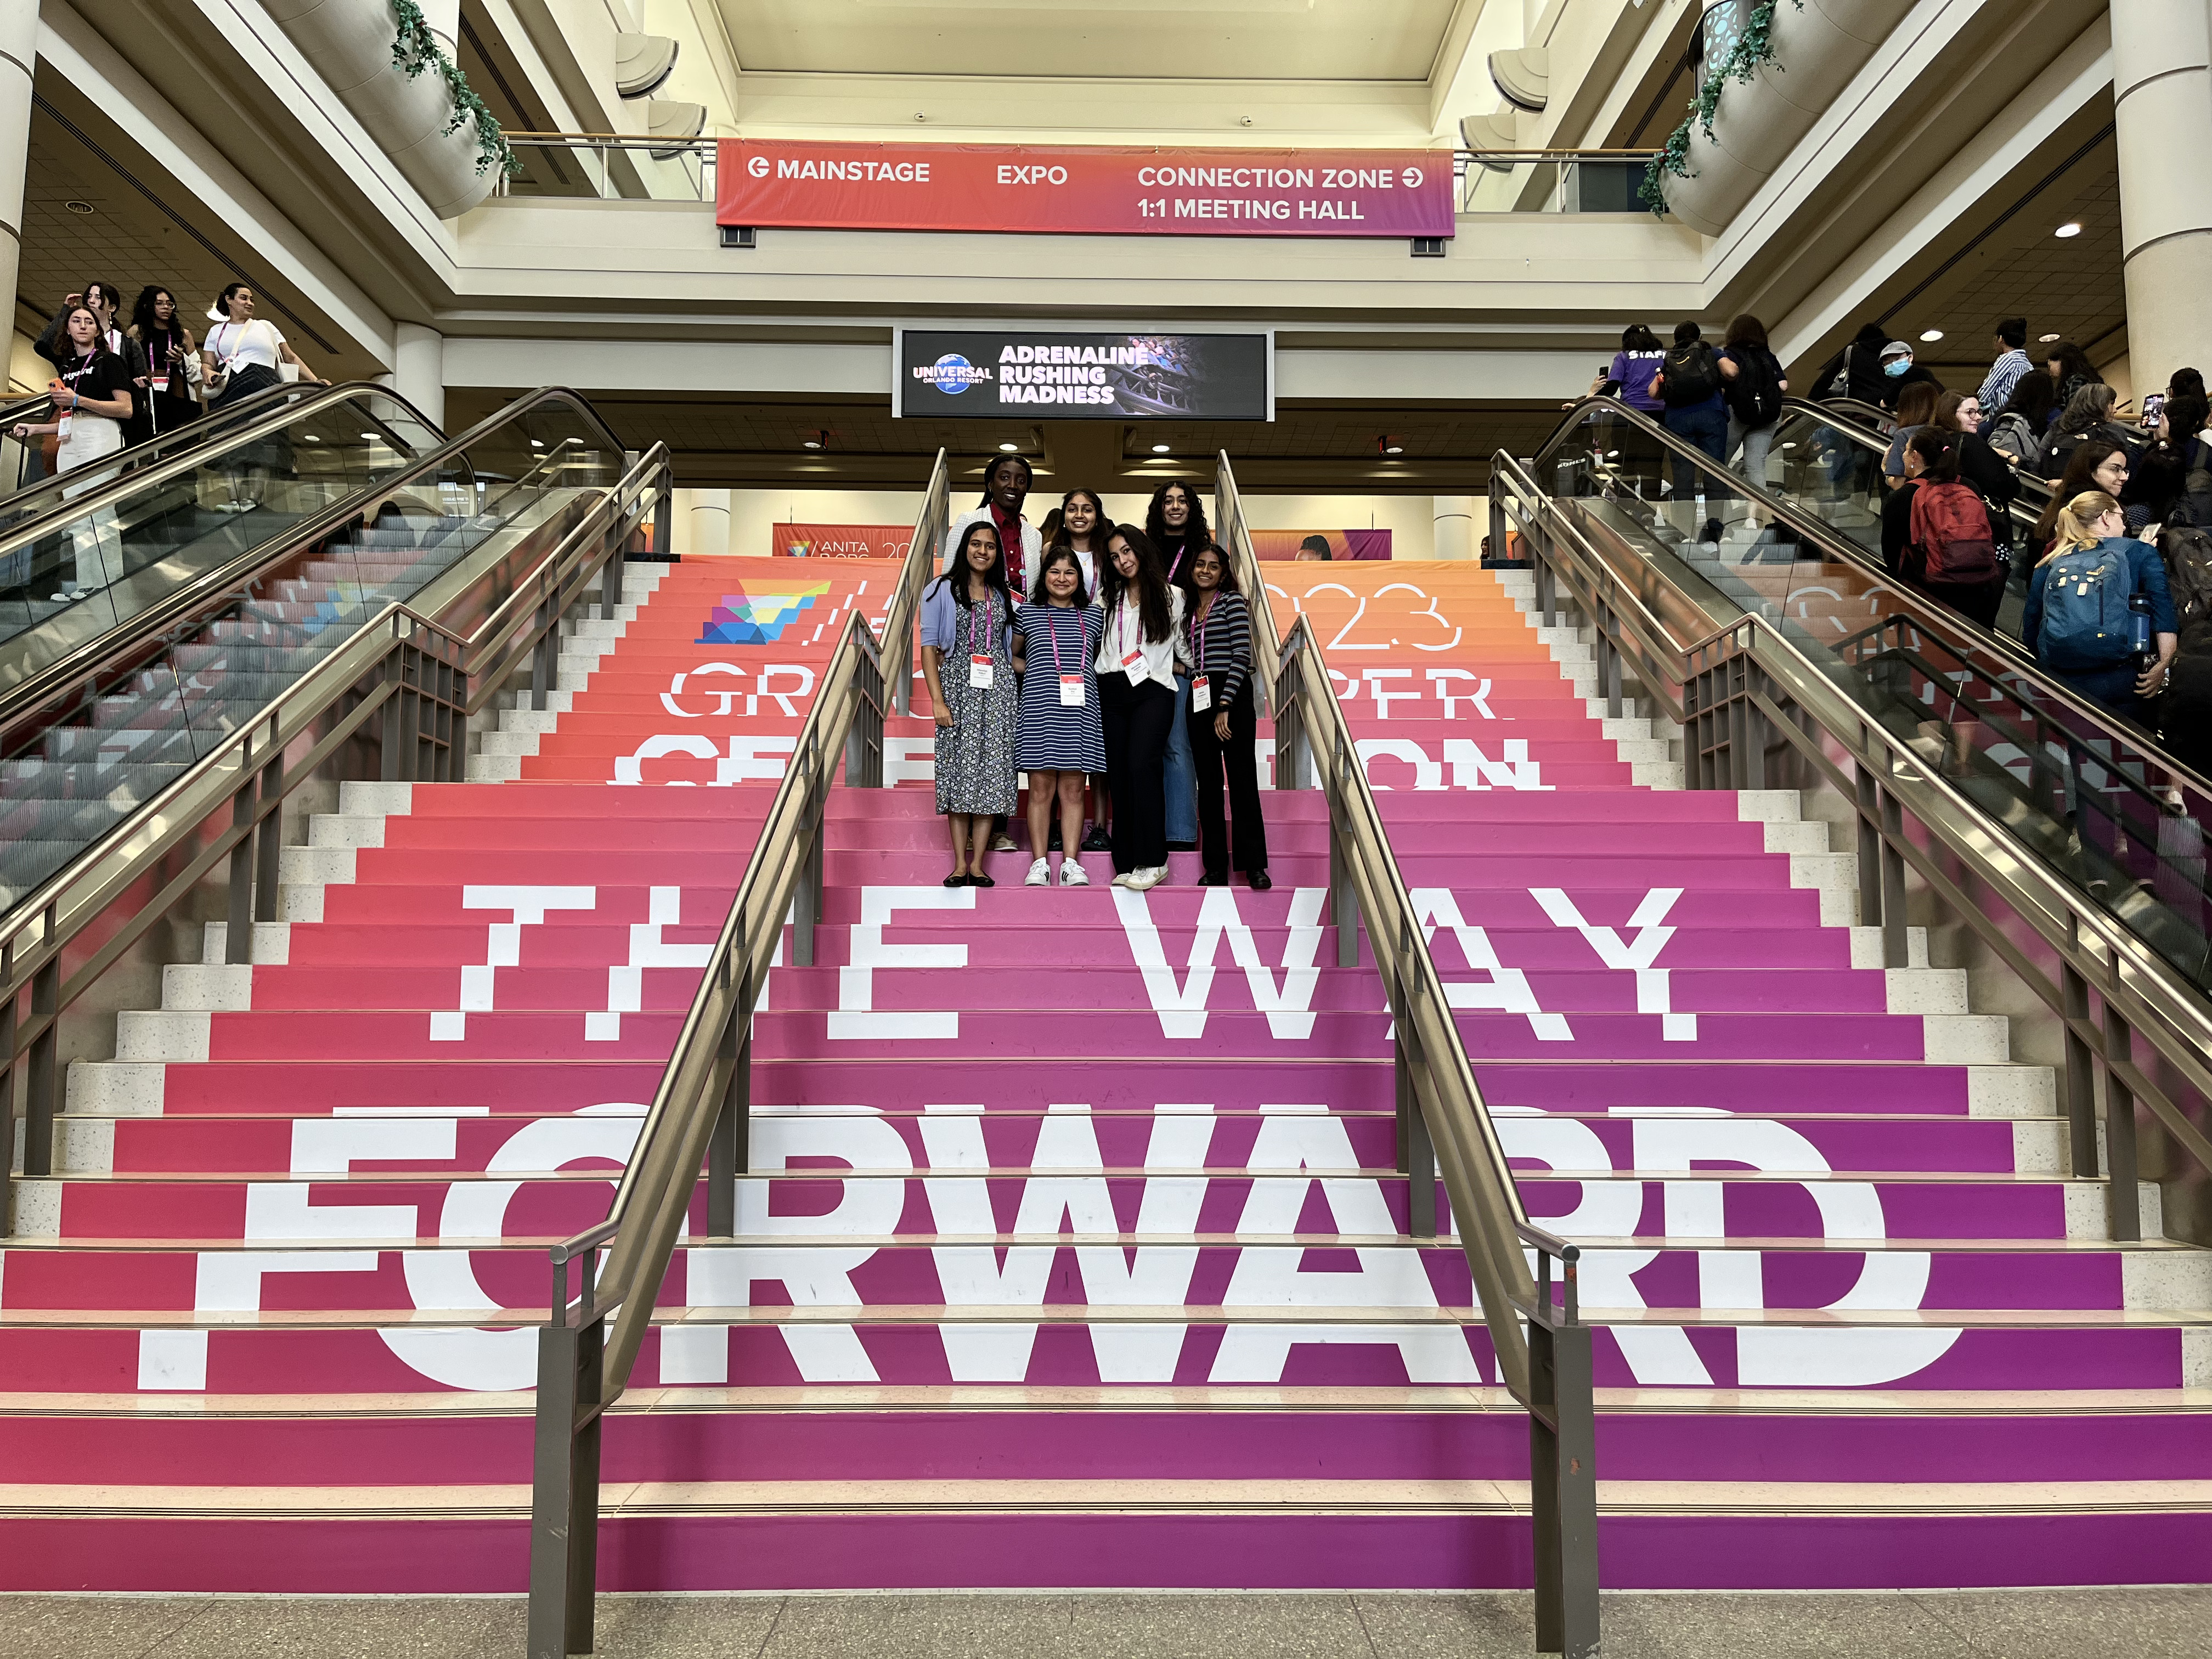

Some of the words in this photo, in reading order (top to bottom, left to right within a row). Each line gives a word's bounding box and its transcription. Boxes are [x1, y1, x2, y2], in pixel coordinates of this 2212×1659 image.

[777, 160, 930, 182] MAINSTAGE
[997, 165, 1068, 185] EXPO
[1138, 167, 1313, 188] CONNECTION
[1322, 169, 1393, 188] ZONE
[1137, 198, 1166, 217] 1:1
[1175, 199, 1290, 219] MEETING
[1299, 200, 1364, 219] HALL
[998, 346, 1149, 365] ADRENALINE
[913, 366, 993, 380] UNIVERSAL
[1000, 366, 1106, 385] RUSHING
[999, 385, 1115, 404] MADNESS
[821, 541, 870, 553] ANITA
[430, 885, 975, 1041] THE
[1110, 887, 1697, 1041] WAY
[137, 1102, 1965, 1392] FORWARD
